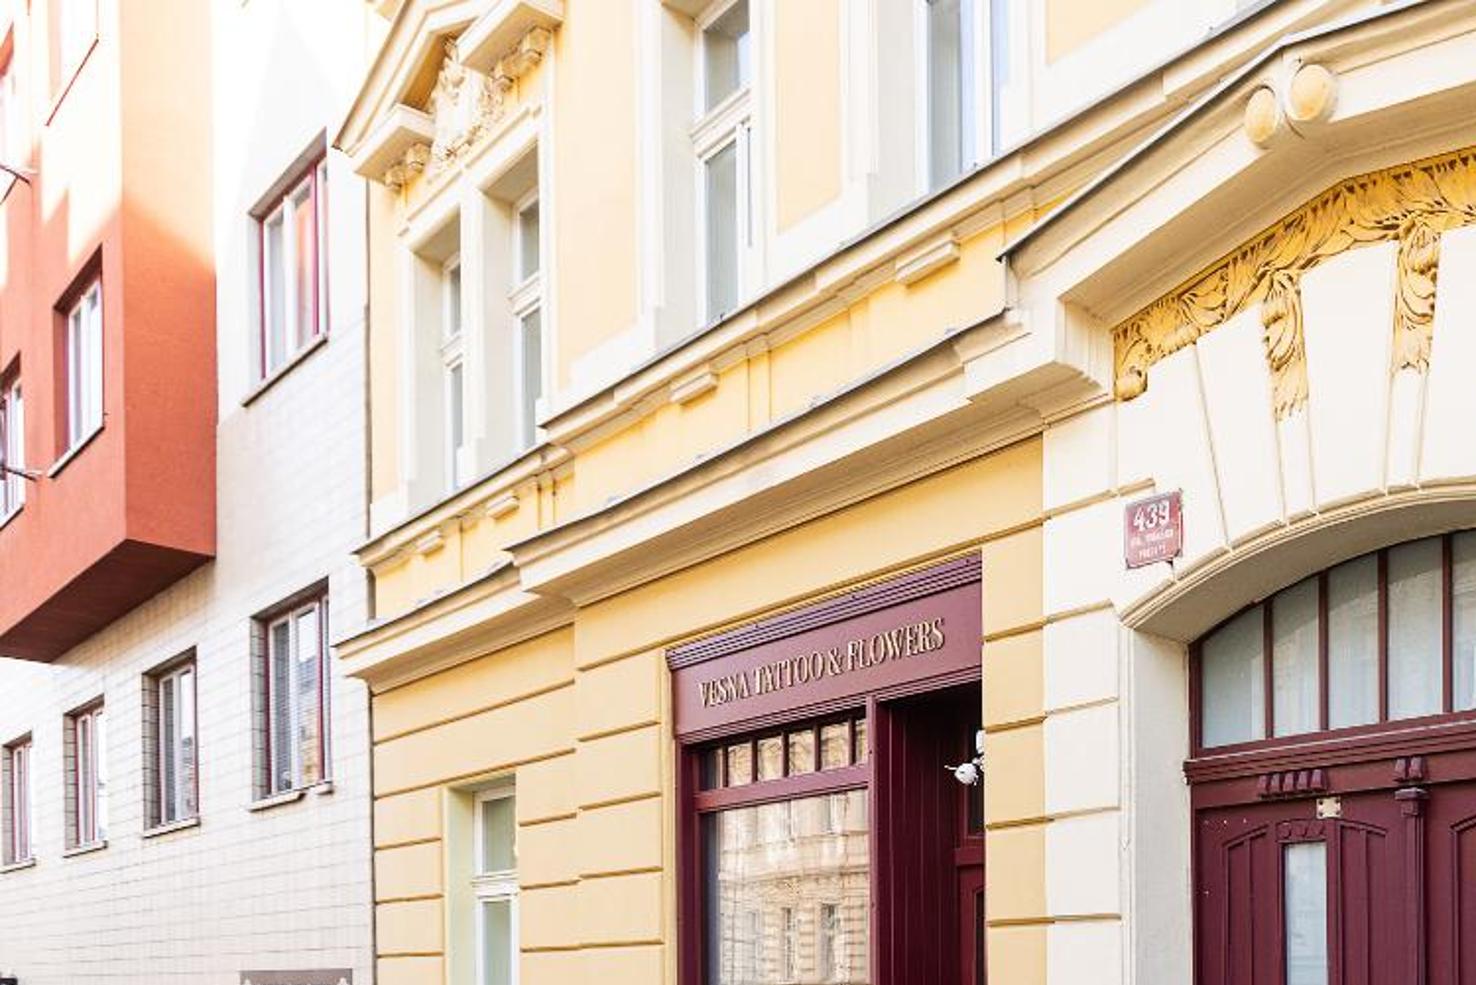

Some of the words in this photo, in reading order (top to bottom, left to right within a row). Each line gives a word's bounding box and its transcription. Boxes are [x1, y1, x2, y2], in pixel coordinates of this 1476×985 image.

[1133, 500, 1170, 532] 439
[698, 671, 750, 709] VESNA
[753, 650, 825, 696] TATTOO
[827, 646, 844, 677] &
[847, 617, 946, 671] FLOWERS
